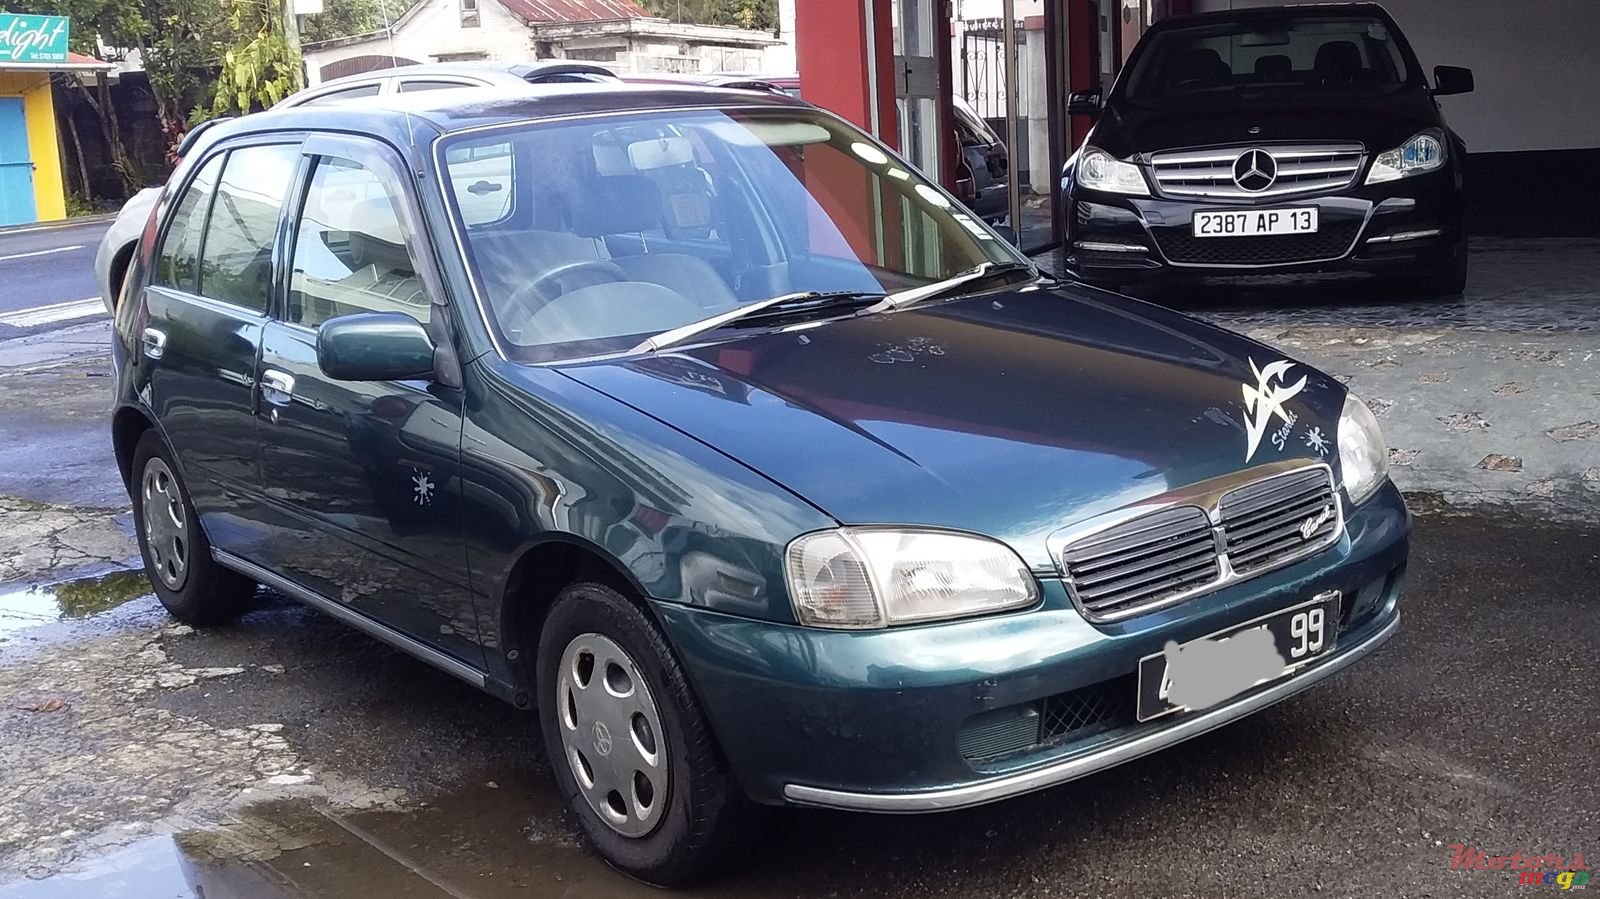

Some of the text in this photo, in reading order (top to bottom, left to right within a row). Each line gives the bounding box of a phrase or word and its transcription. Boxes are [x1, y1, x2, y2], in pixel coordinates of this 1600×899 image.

[1201, 211, 1311, 233] 2387 AP 13
[1271, 409, 1298, 451] Starlet
[1291, 608, 1324, 658] 99
